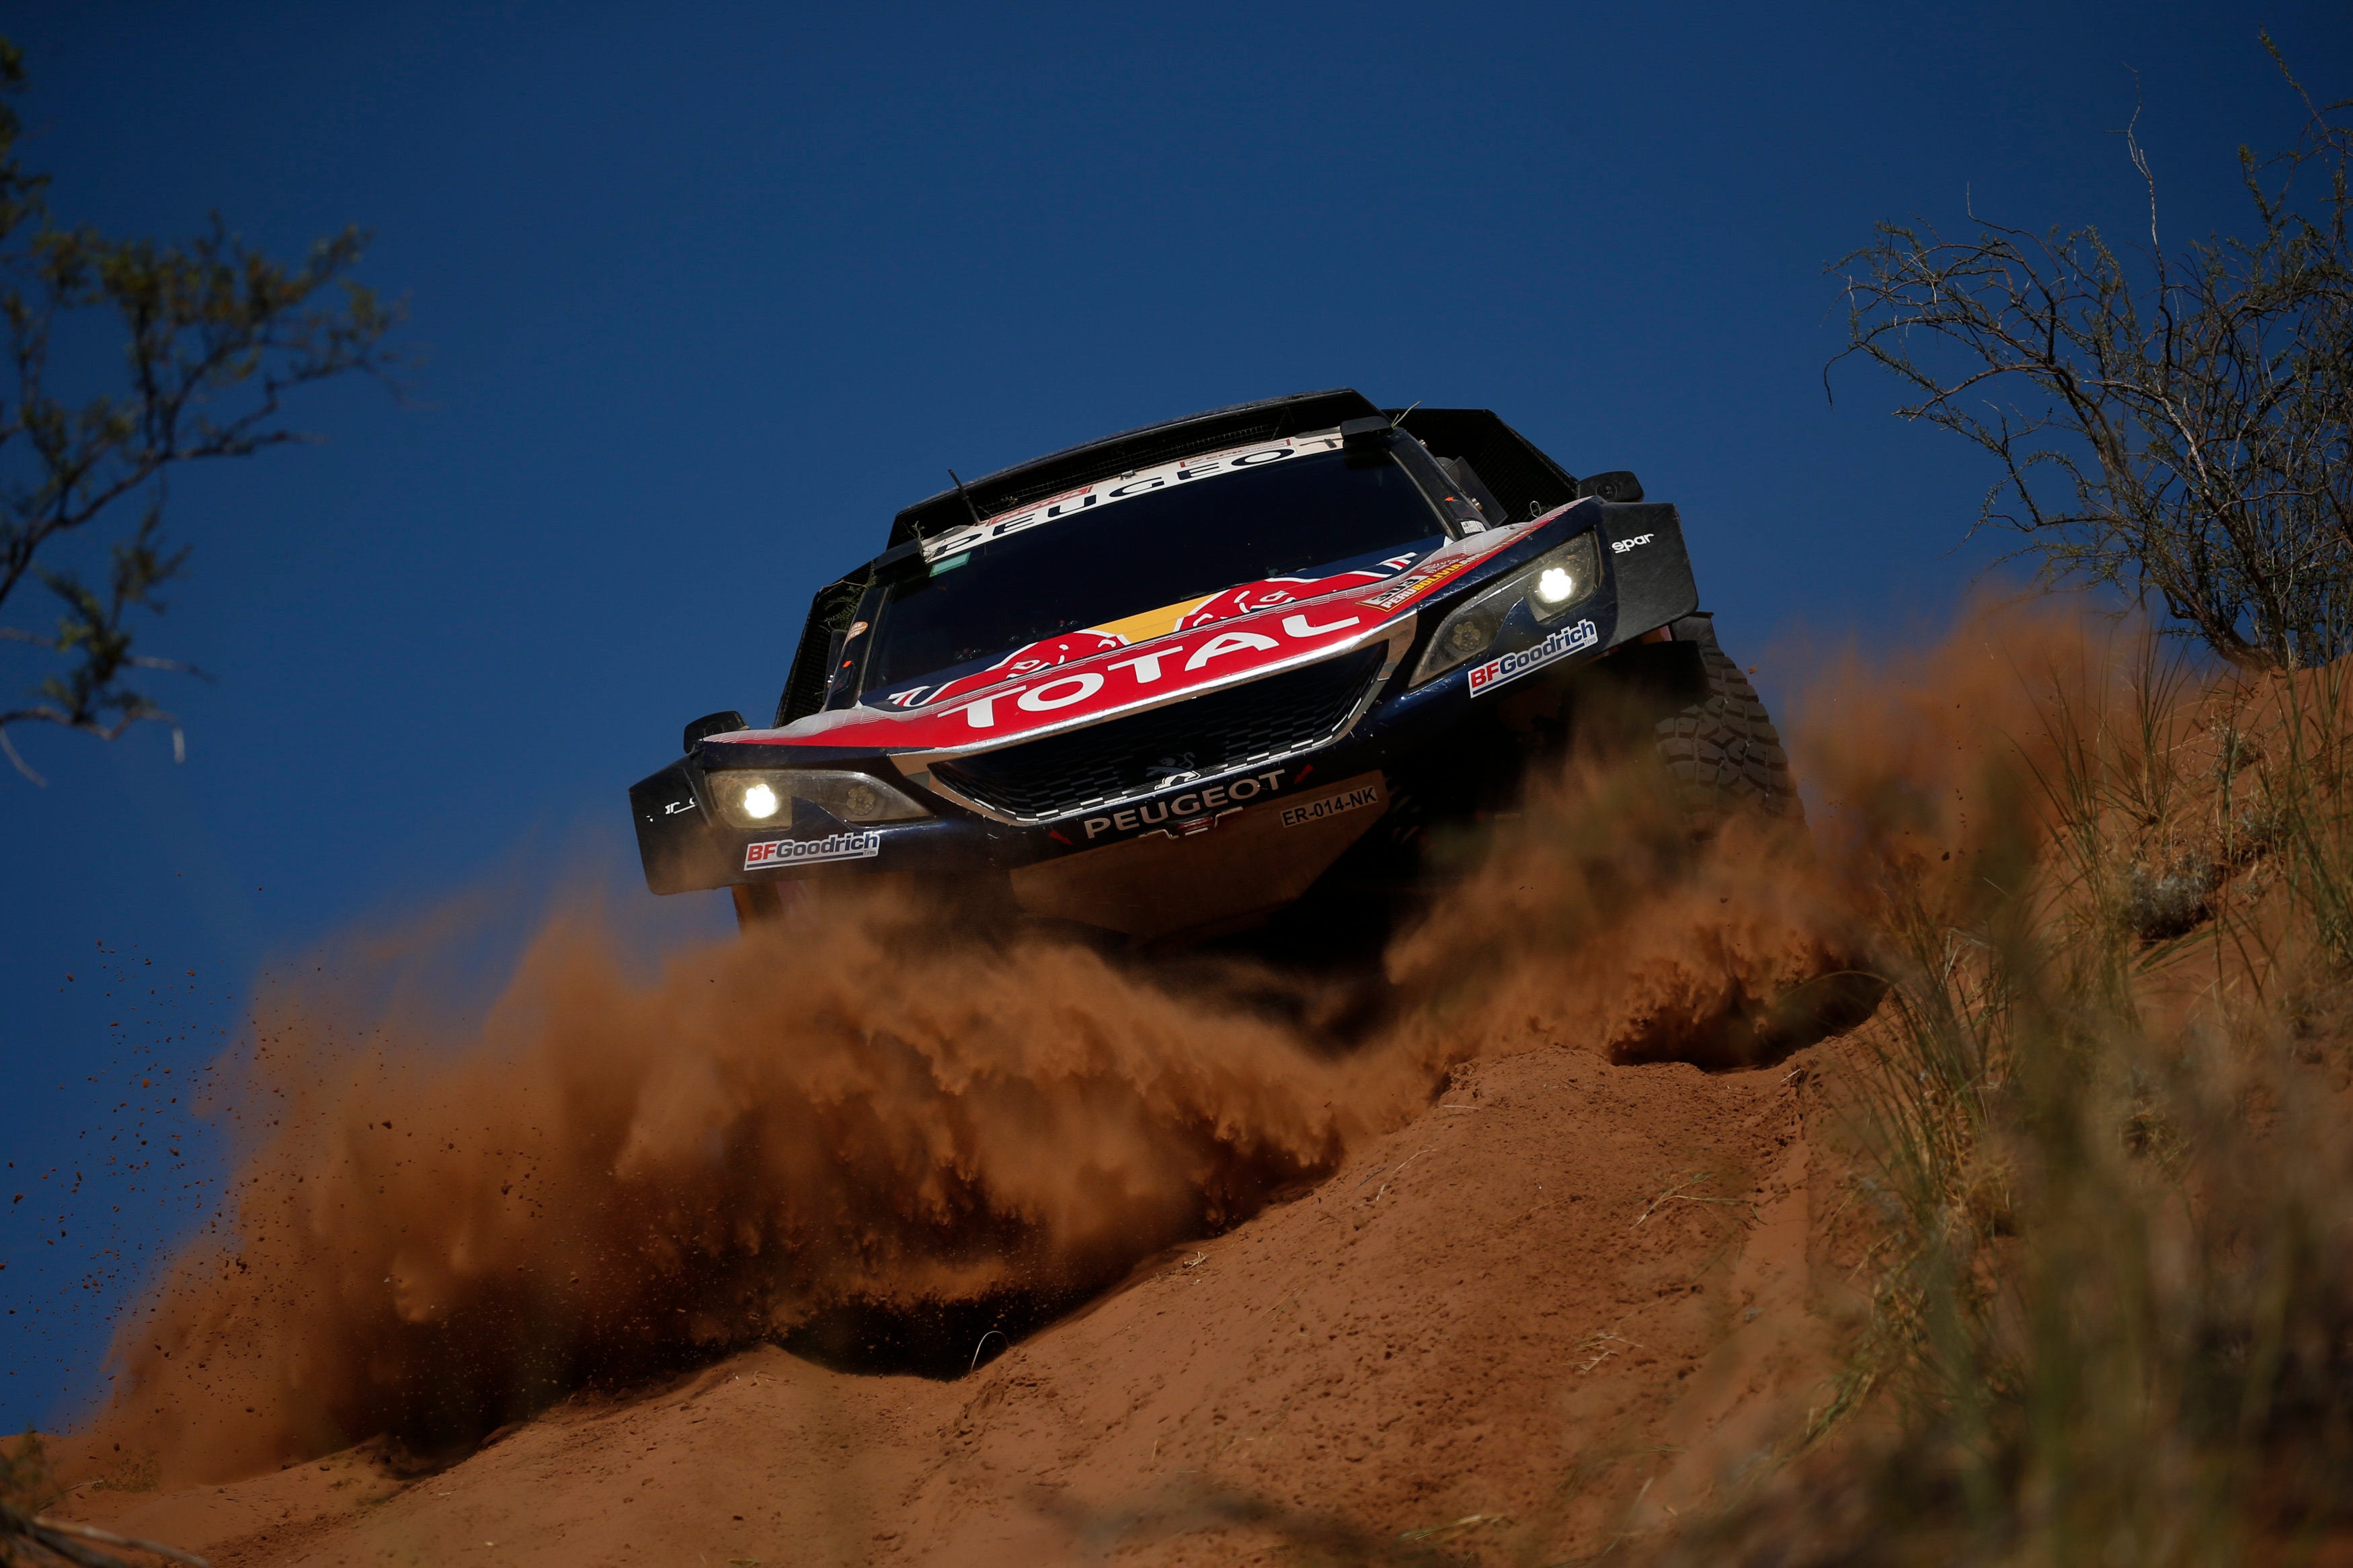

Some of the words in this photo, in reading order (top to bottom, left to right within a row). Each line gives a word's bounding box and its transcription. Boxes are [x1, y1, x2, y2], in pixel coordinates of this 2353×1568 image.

[1611, 533, 1654, 553] spar
[938, 614, 1360, 728] TOTAL
[1470, 622, 1595, 688] BFGoodrich
[1084, 770, 1285, 839] PEUGEOT
[1284, 789, 1378, 827] ER-014-NK
[748, 833, 879, 862] BFGoodrich
